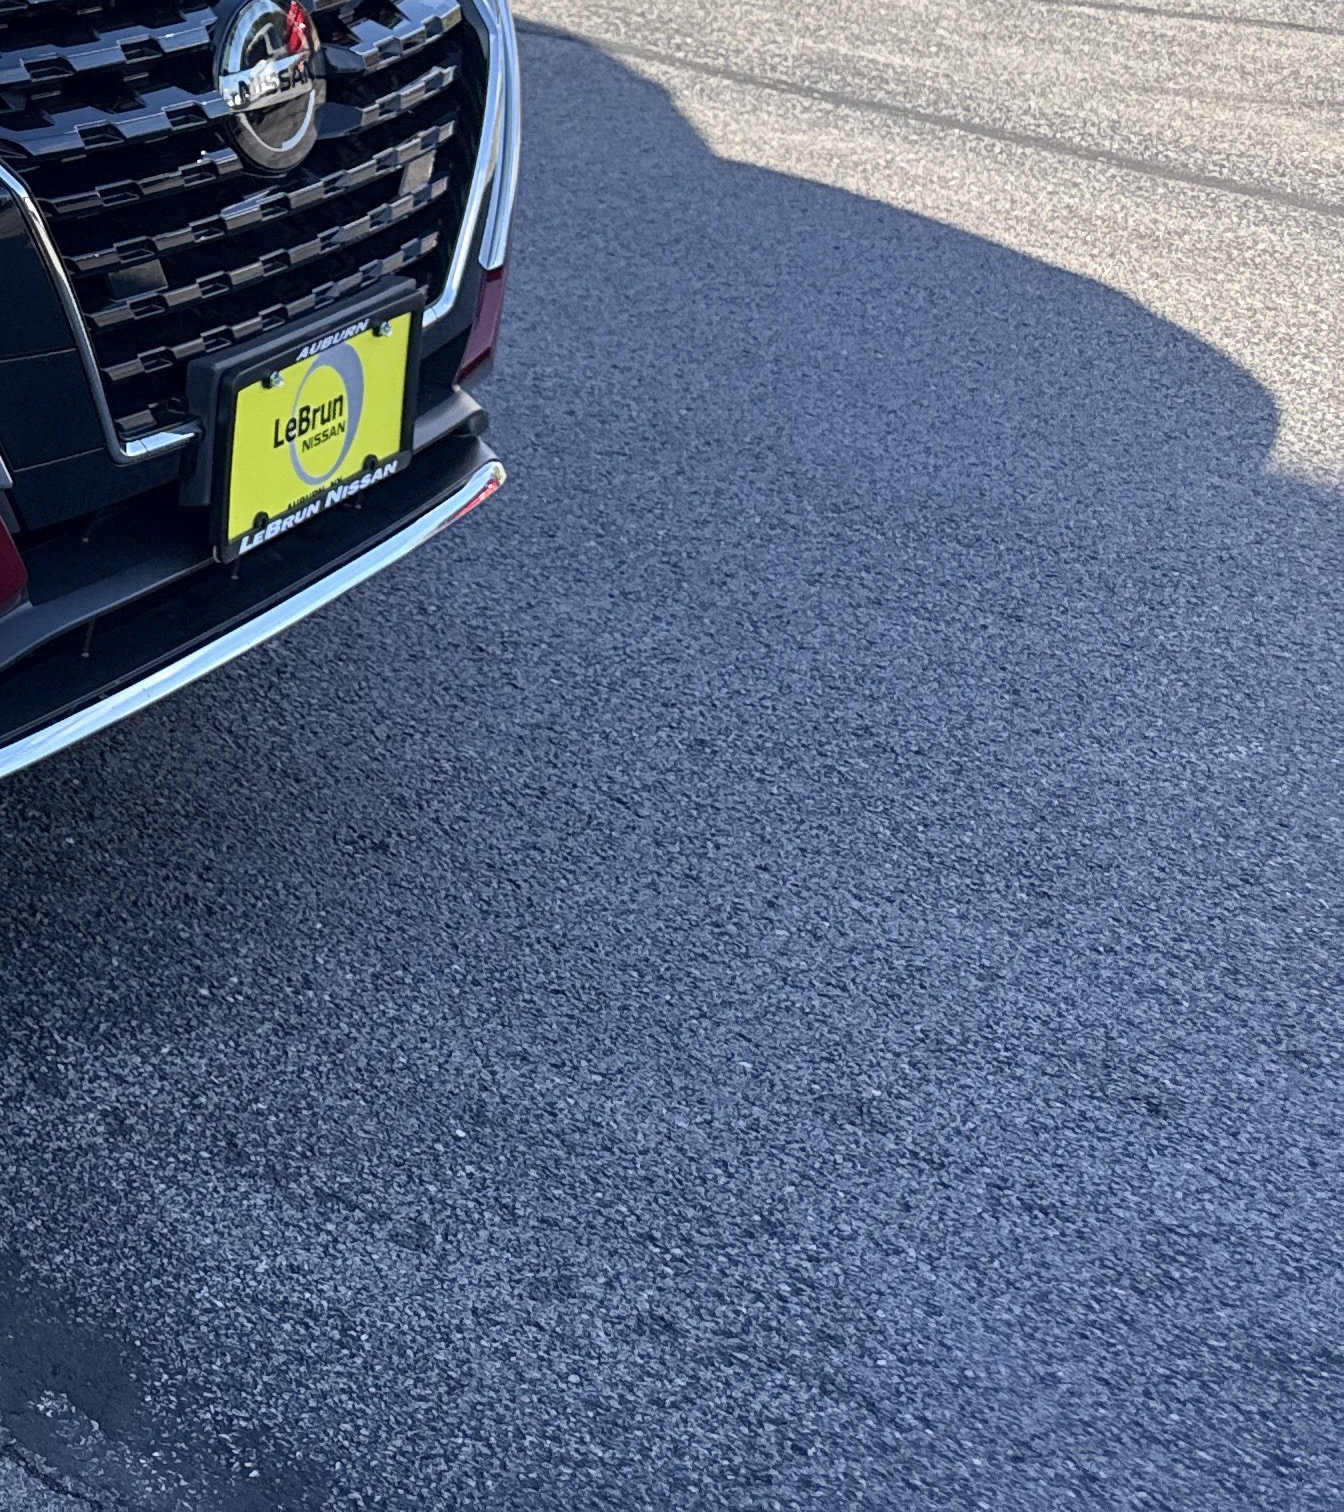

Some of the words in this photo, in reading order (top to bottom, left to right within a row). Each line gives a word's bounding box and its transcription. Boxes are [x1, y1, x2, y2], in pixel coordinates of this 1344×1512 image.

[296, 319, 370, 361] AUBURN
[273, 394, 344, 449] LeBrun
[302, 420, 346, 453] NISSAN
